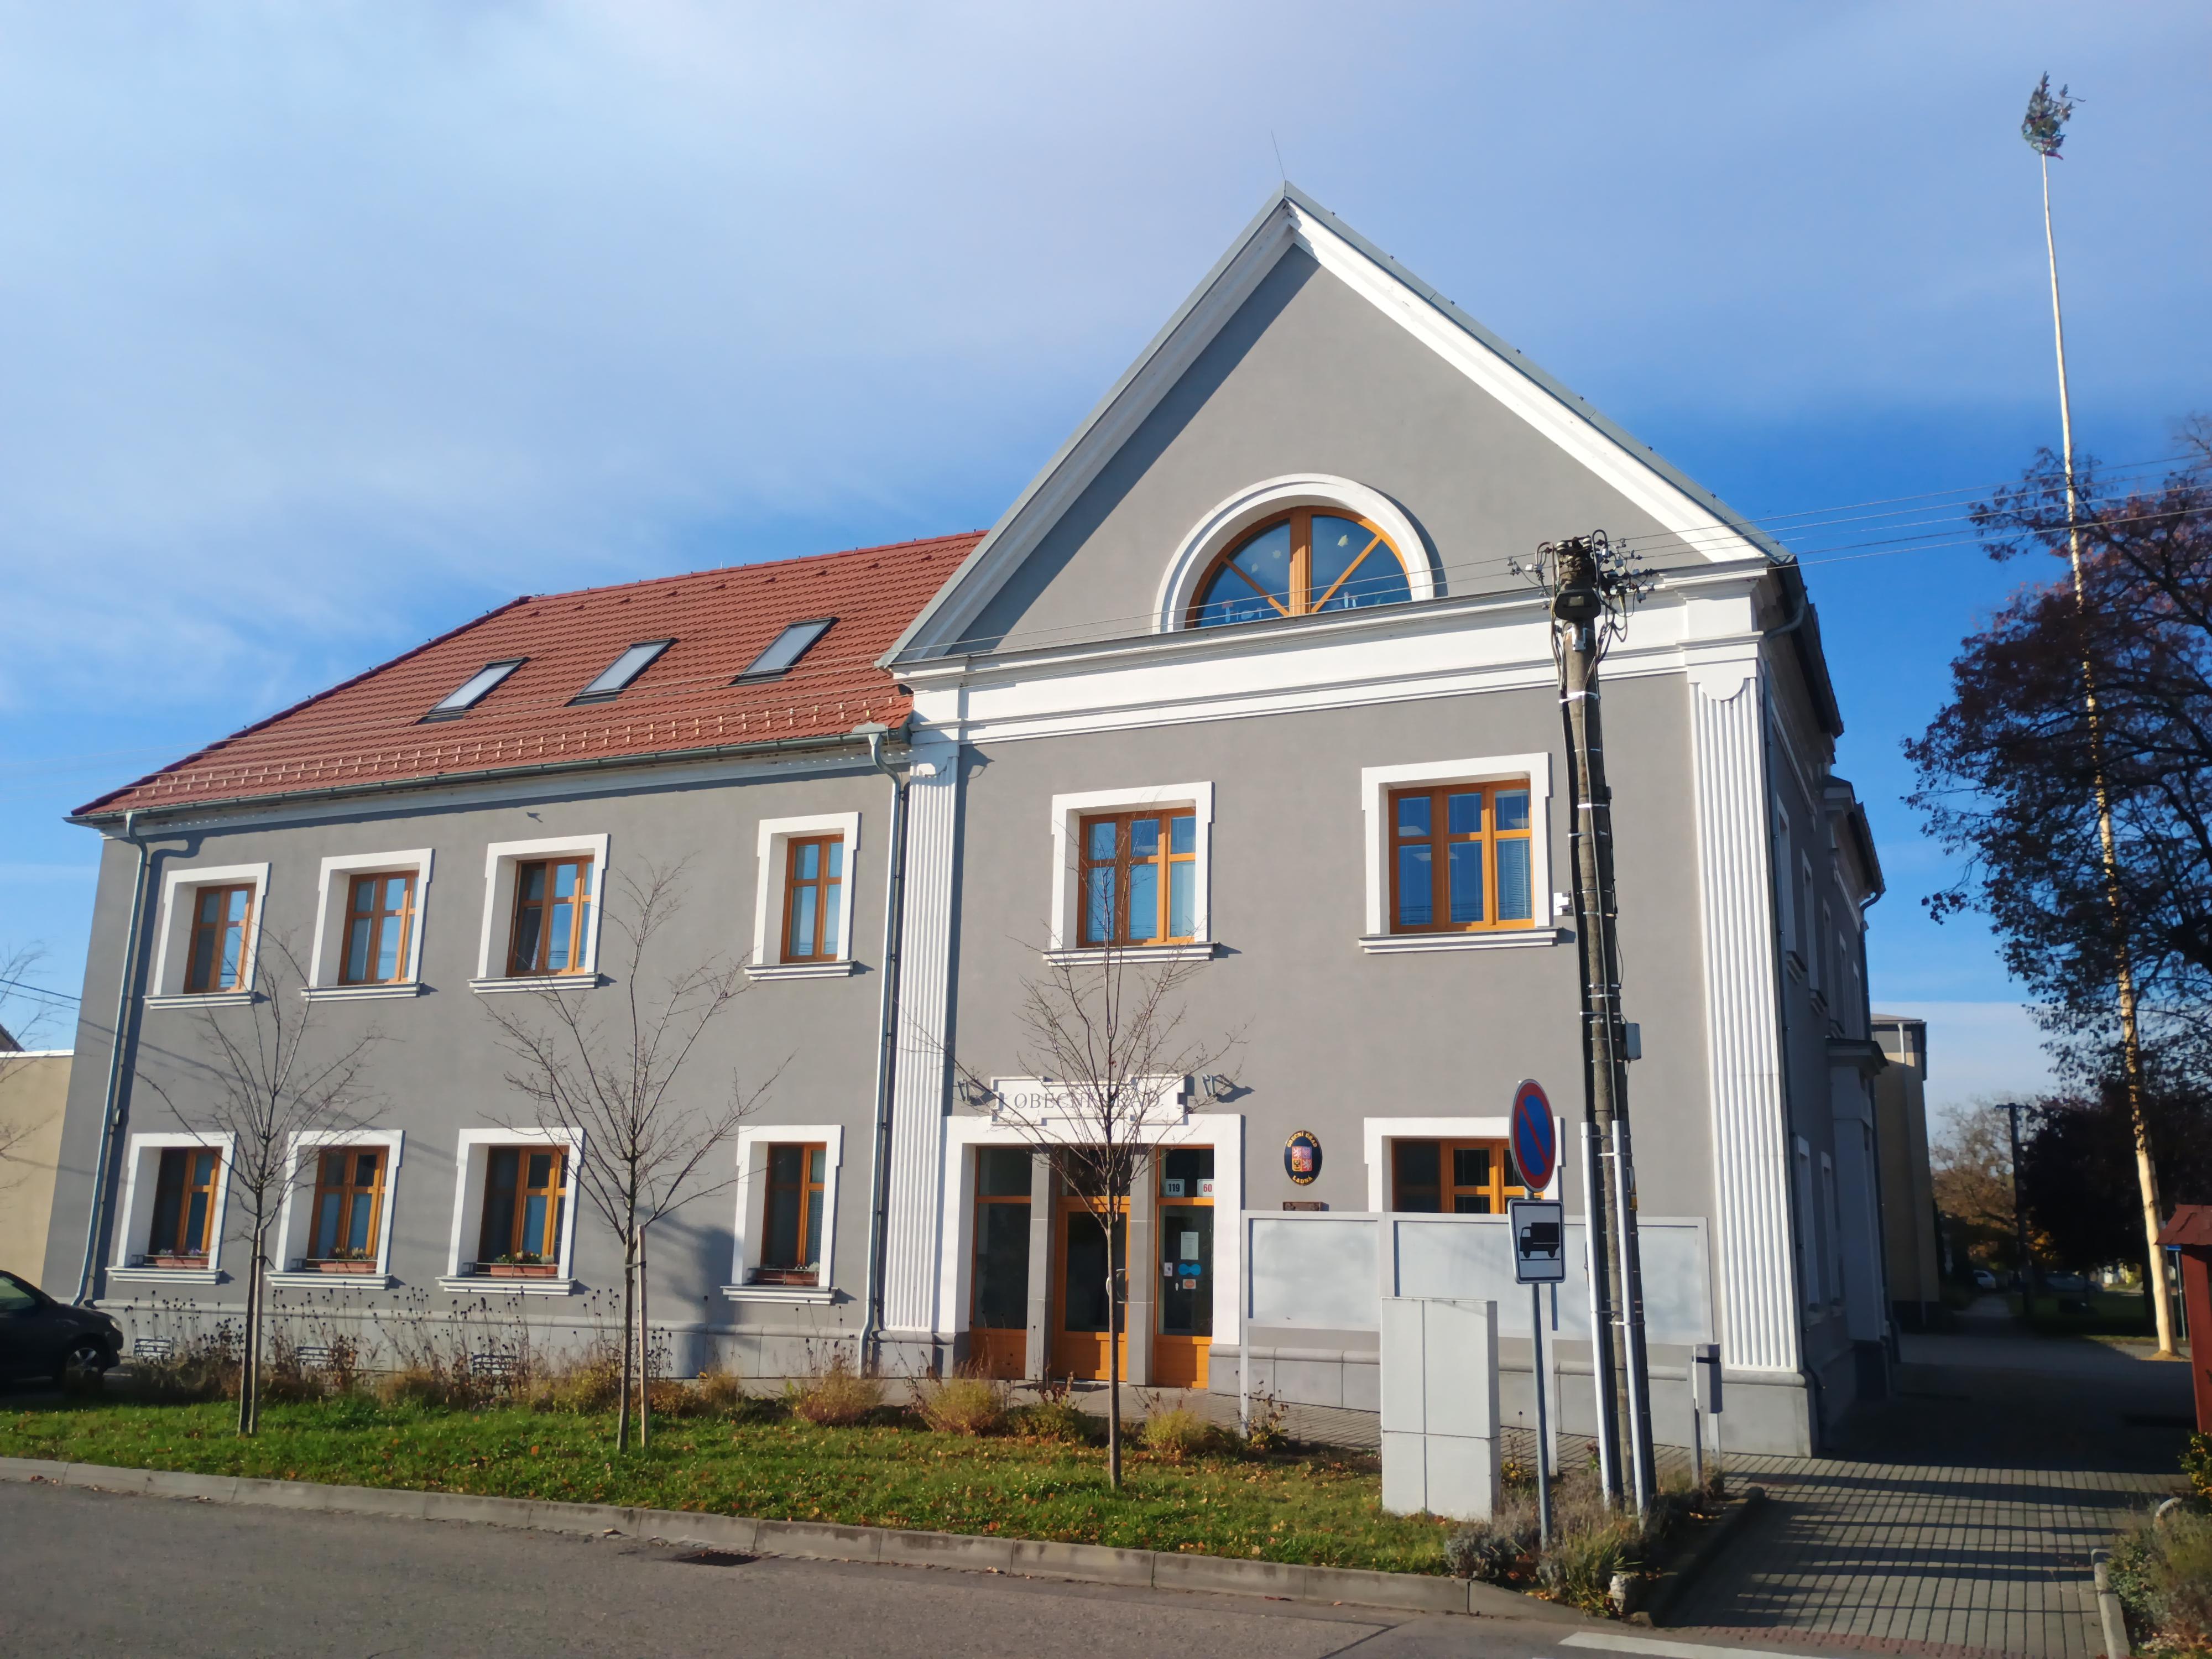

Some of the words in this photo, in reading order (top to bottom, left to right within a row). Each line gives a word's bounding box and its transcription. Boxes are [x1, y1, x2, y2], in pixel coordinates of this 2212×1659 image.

[1292, 1175, 1313, 1184] LADNÁ
[1168, 1183, 1180, 1192] 119
[1203, 1183, 1212, 1192] 60
